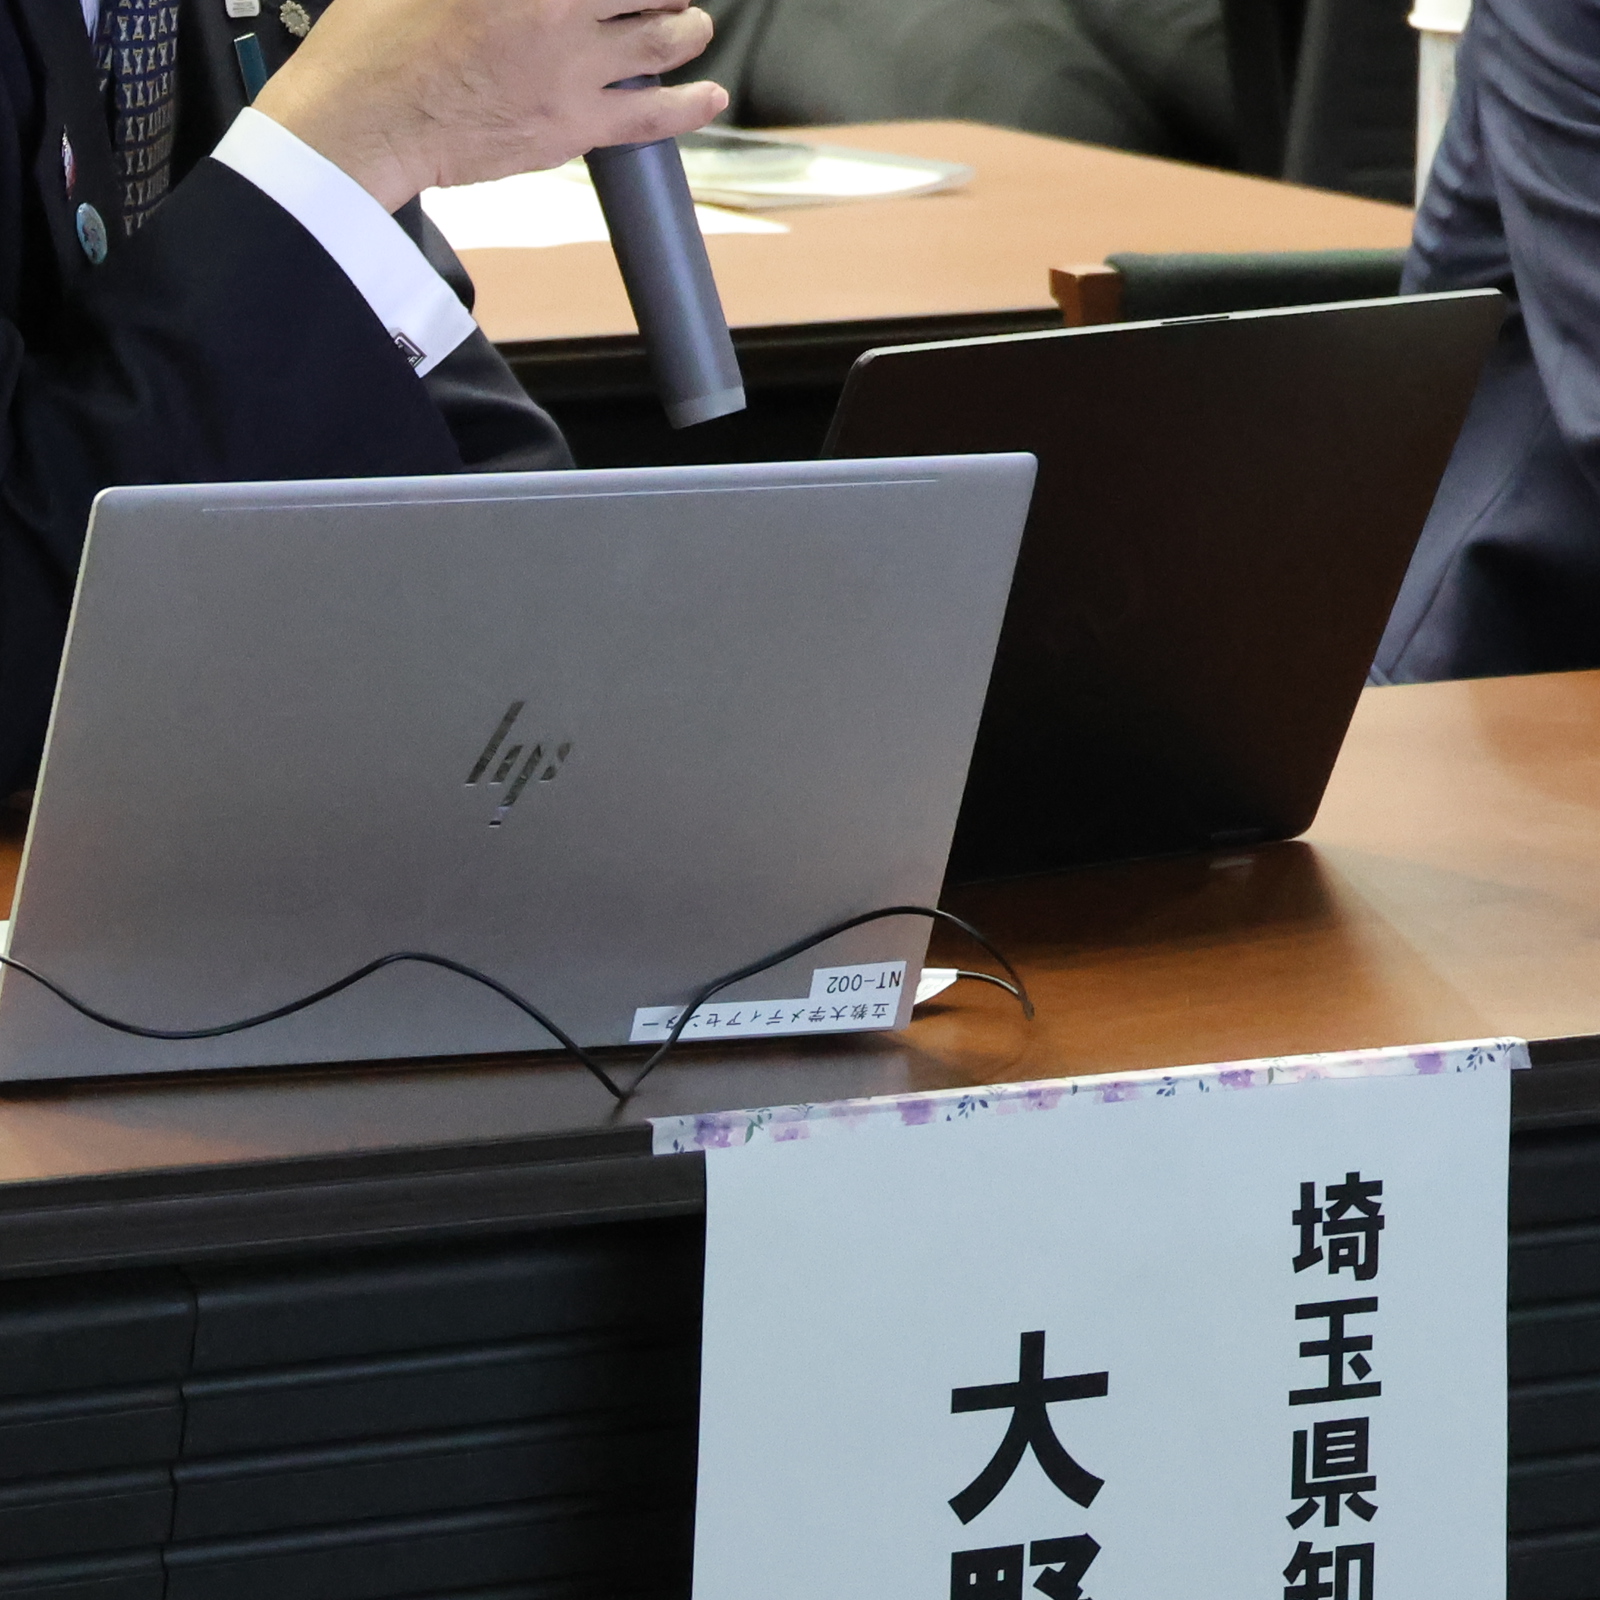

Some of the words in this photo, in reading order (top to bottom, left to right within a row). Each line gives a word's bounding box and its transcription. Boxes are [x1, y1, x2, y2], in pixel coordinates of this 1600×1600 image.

[826, 969, 902, 994] NT-002
[642, 1001, 891, 1030] 立教大学メディアセンター
